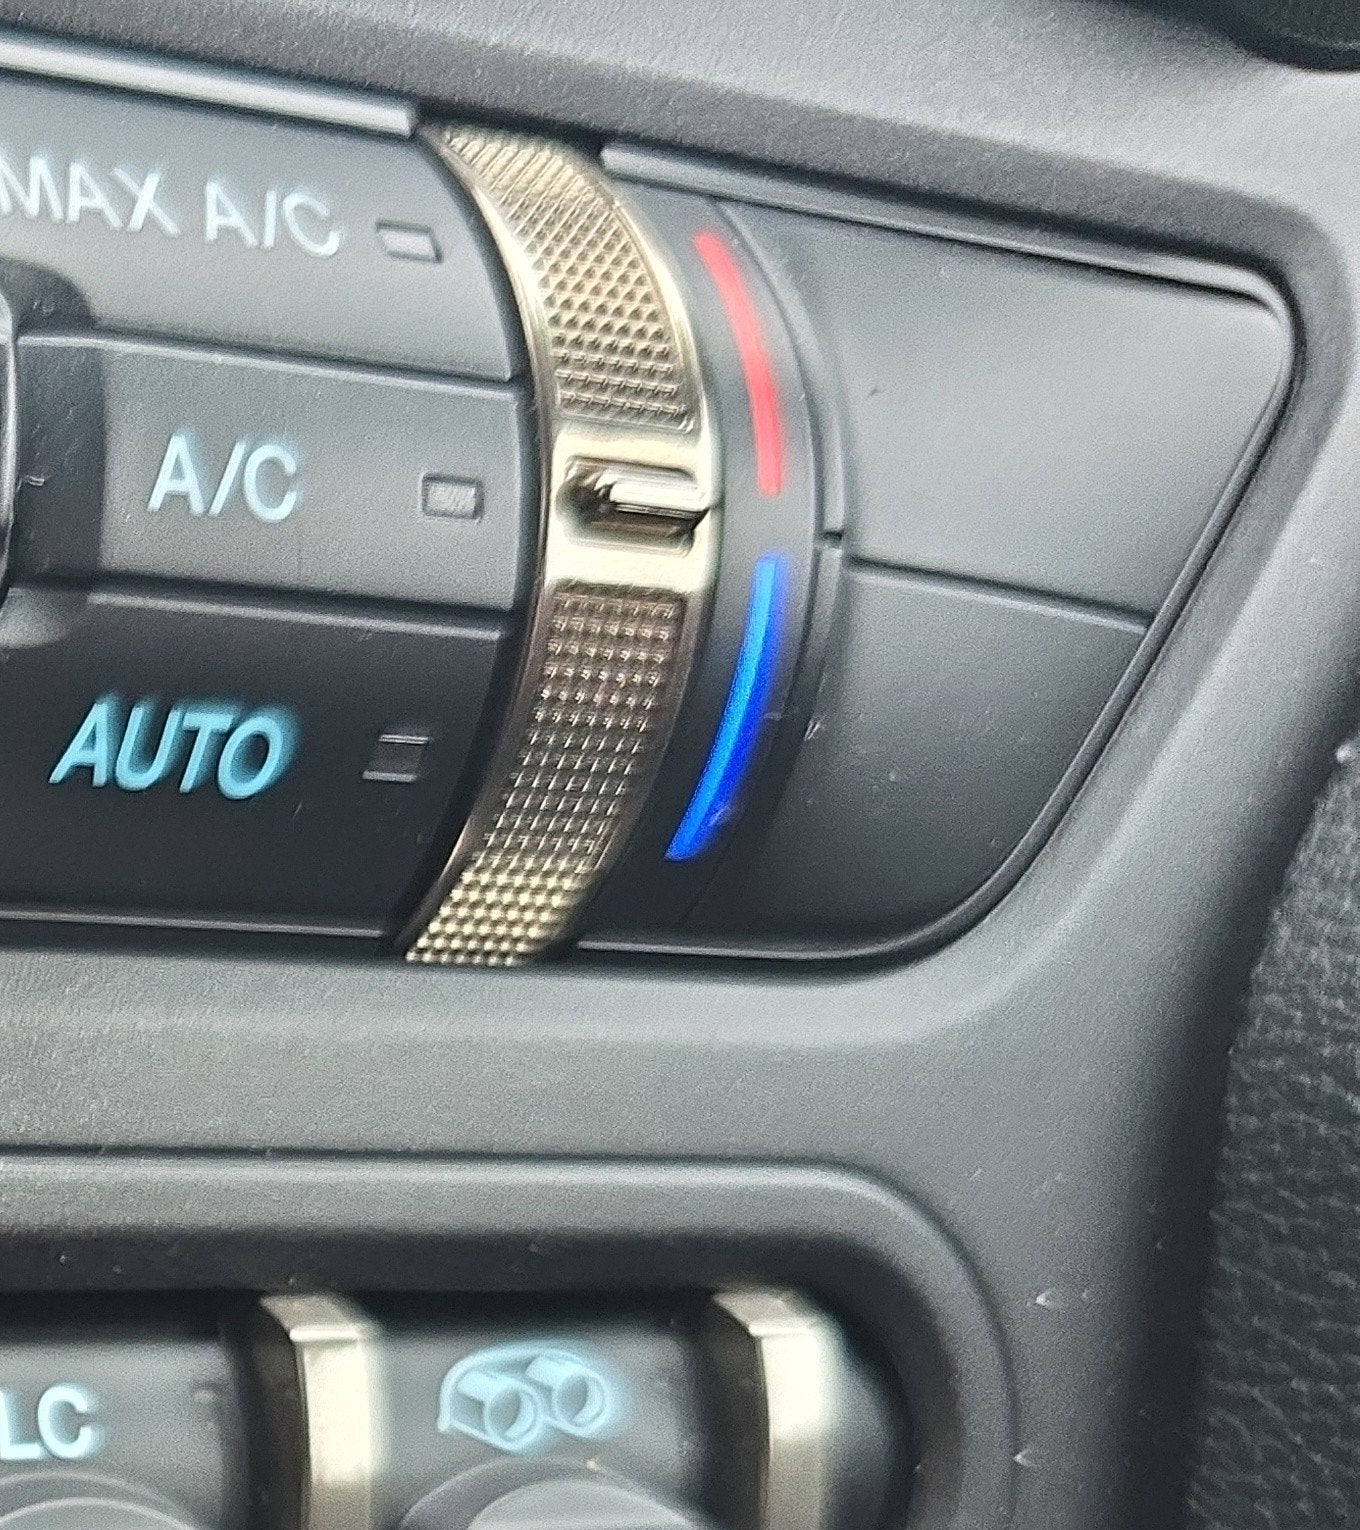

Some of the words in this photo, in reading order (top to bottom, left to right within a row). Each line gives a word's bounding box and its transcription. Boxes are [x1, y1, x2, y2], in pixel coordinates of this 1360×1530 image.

[203, 180, 342, 257] A/C
[147, 433, 300, 522] A/C
[48, 692, 296, 800] AUTO
